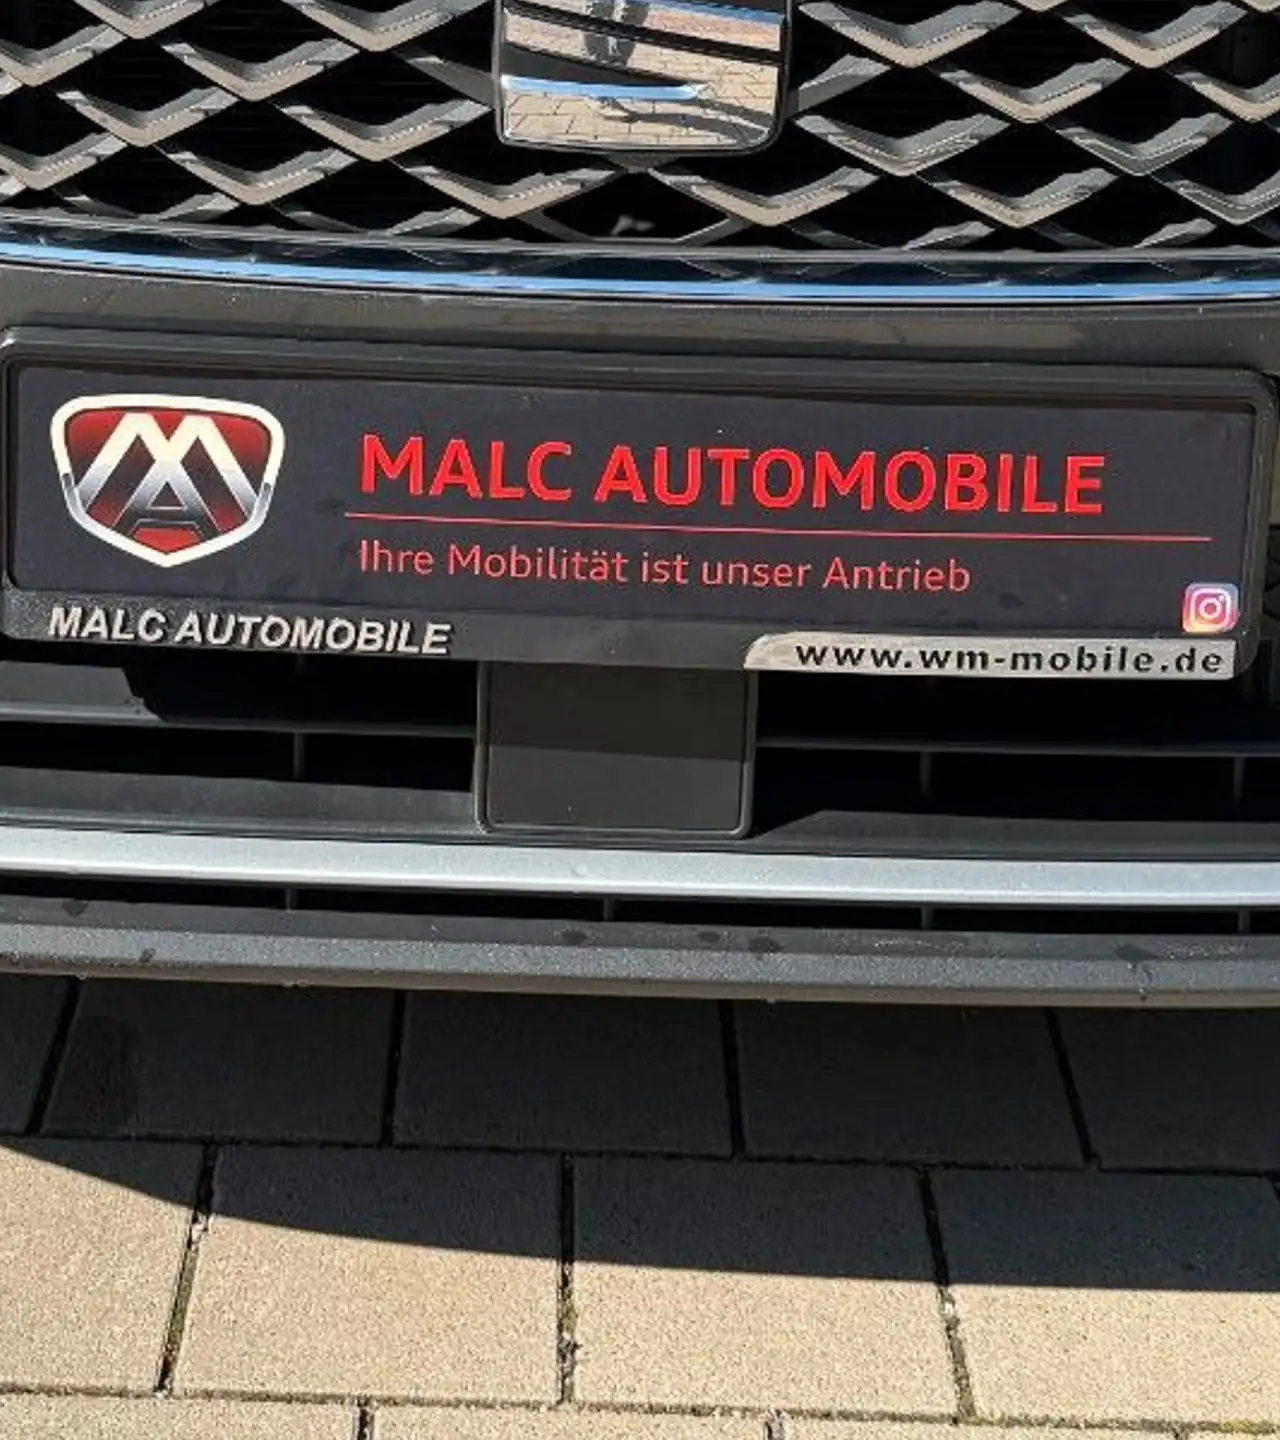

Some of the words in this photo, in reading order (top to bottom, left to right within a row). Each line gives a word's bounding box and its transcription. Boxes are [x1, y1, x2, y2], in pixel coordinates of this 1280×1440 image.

[361, 433, 572, 501] MALC
[593, 444, 1105, 513] AUTOMOBILE
[360, 539, 433, 575] Ihre
[448, 543, 628, 582] Mobilität
[641, 551, 689, 585] ist
[702, 559, 812, 588] unser
[822, 556, 971, 592] Antrieb
[47, 606, 167, 642] MALC
[174, 610, 452, 655] AUTOMOBILE
[795, 644, 1223, 673] www.wm-mobile.de
